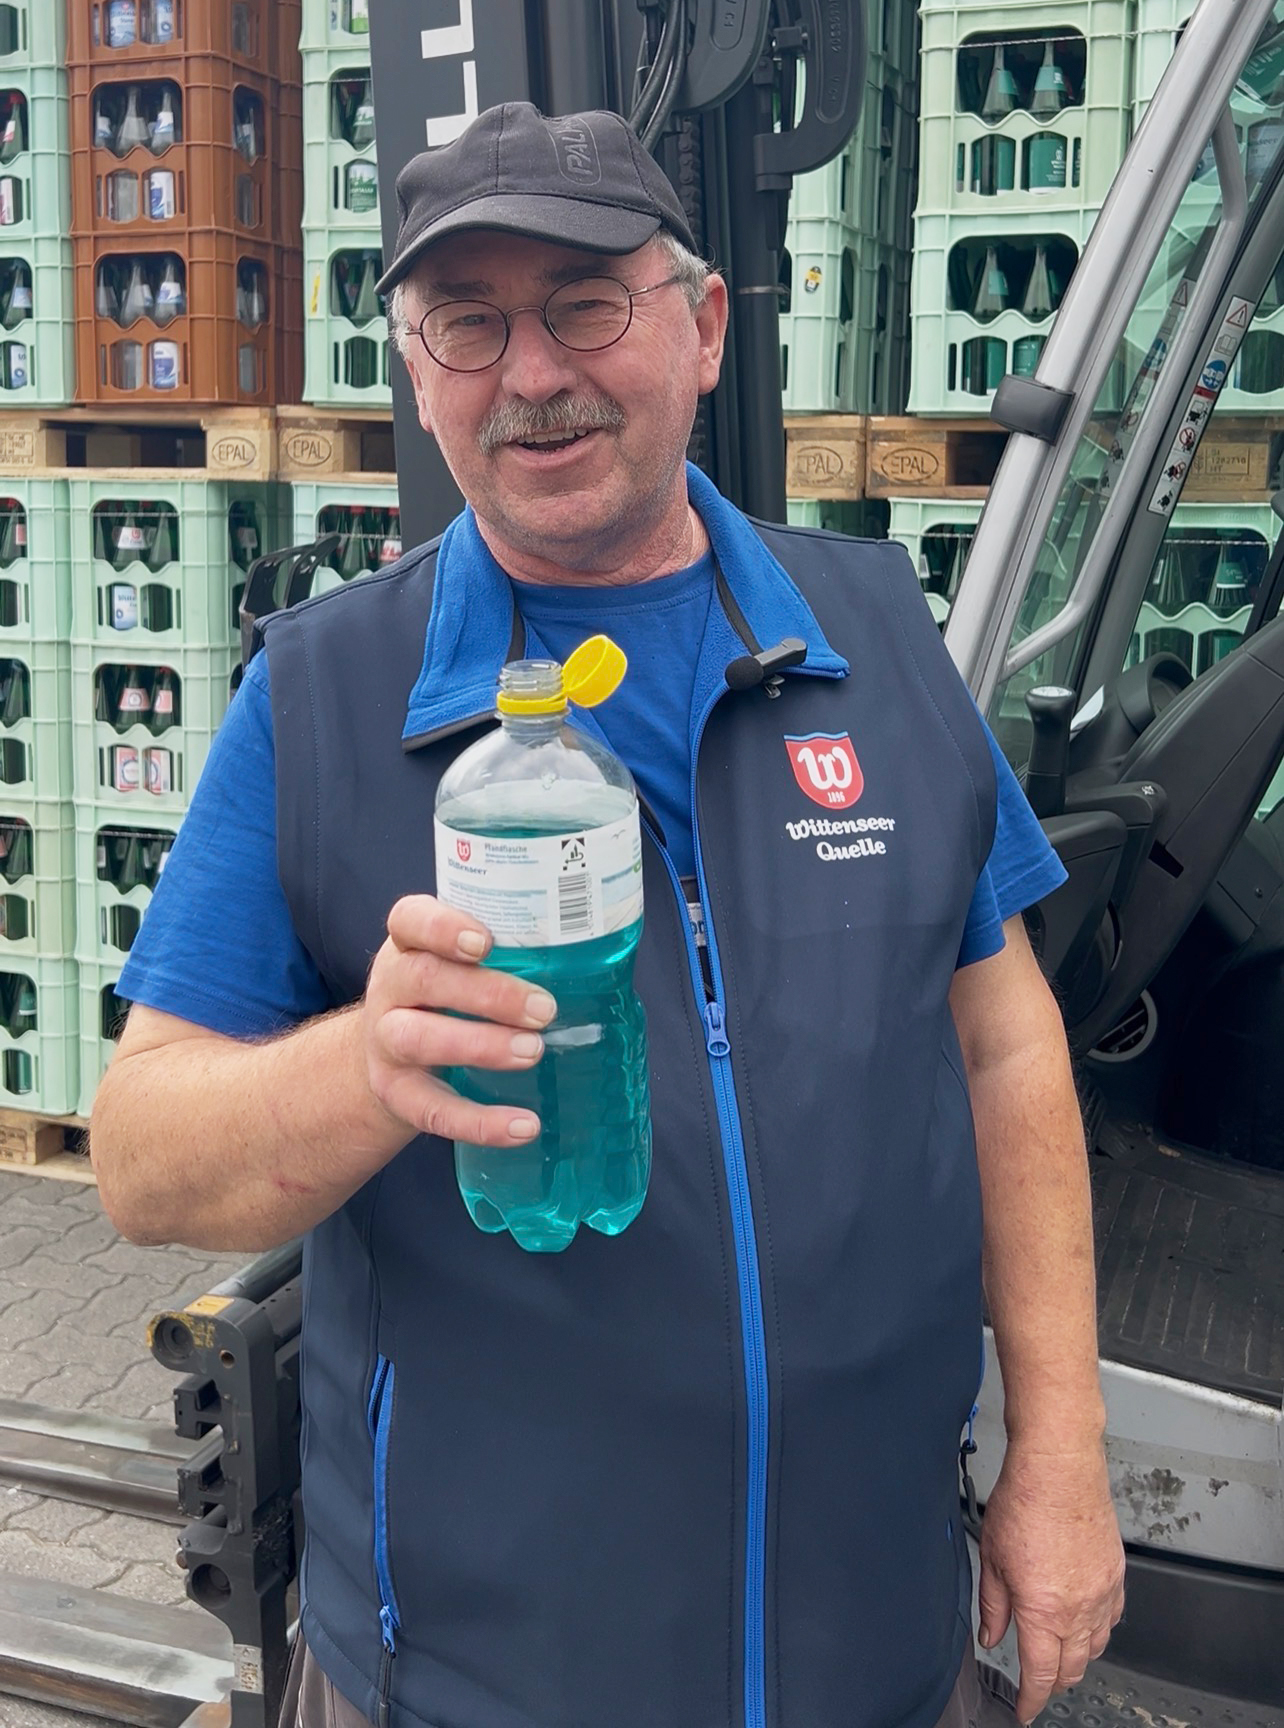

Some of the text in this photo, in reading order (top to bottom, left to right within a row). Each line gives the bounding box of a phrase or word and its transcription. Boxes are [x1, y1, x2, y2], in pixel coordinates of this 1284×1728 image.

[218, 444, 249, 462] EPAL
[293, 440, 325, 460] EPAL
[785, 817, 896, 841] Wittenseer
[816, 837, 887, 861] Quelle
